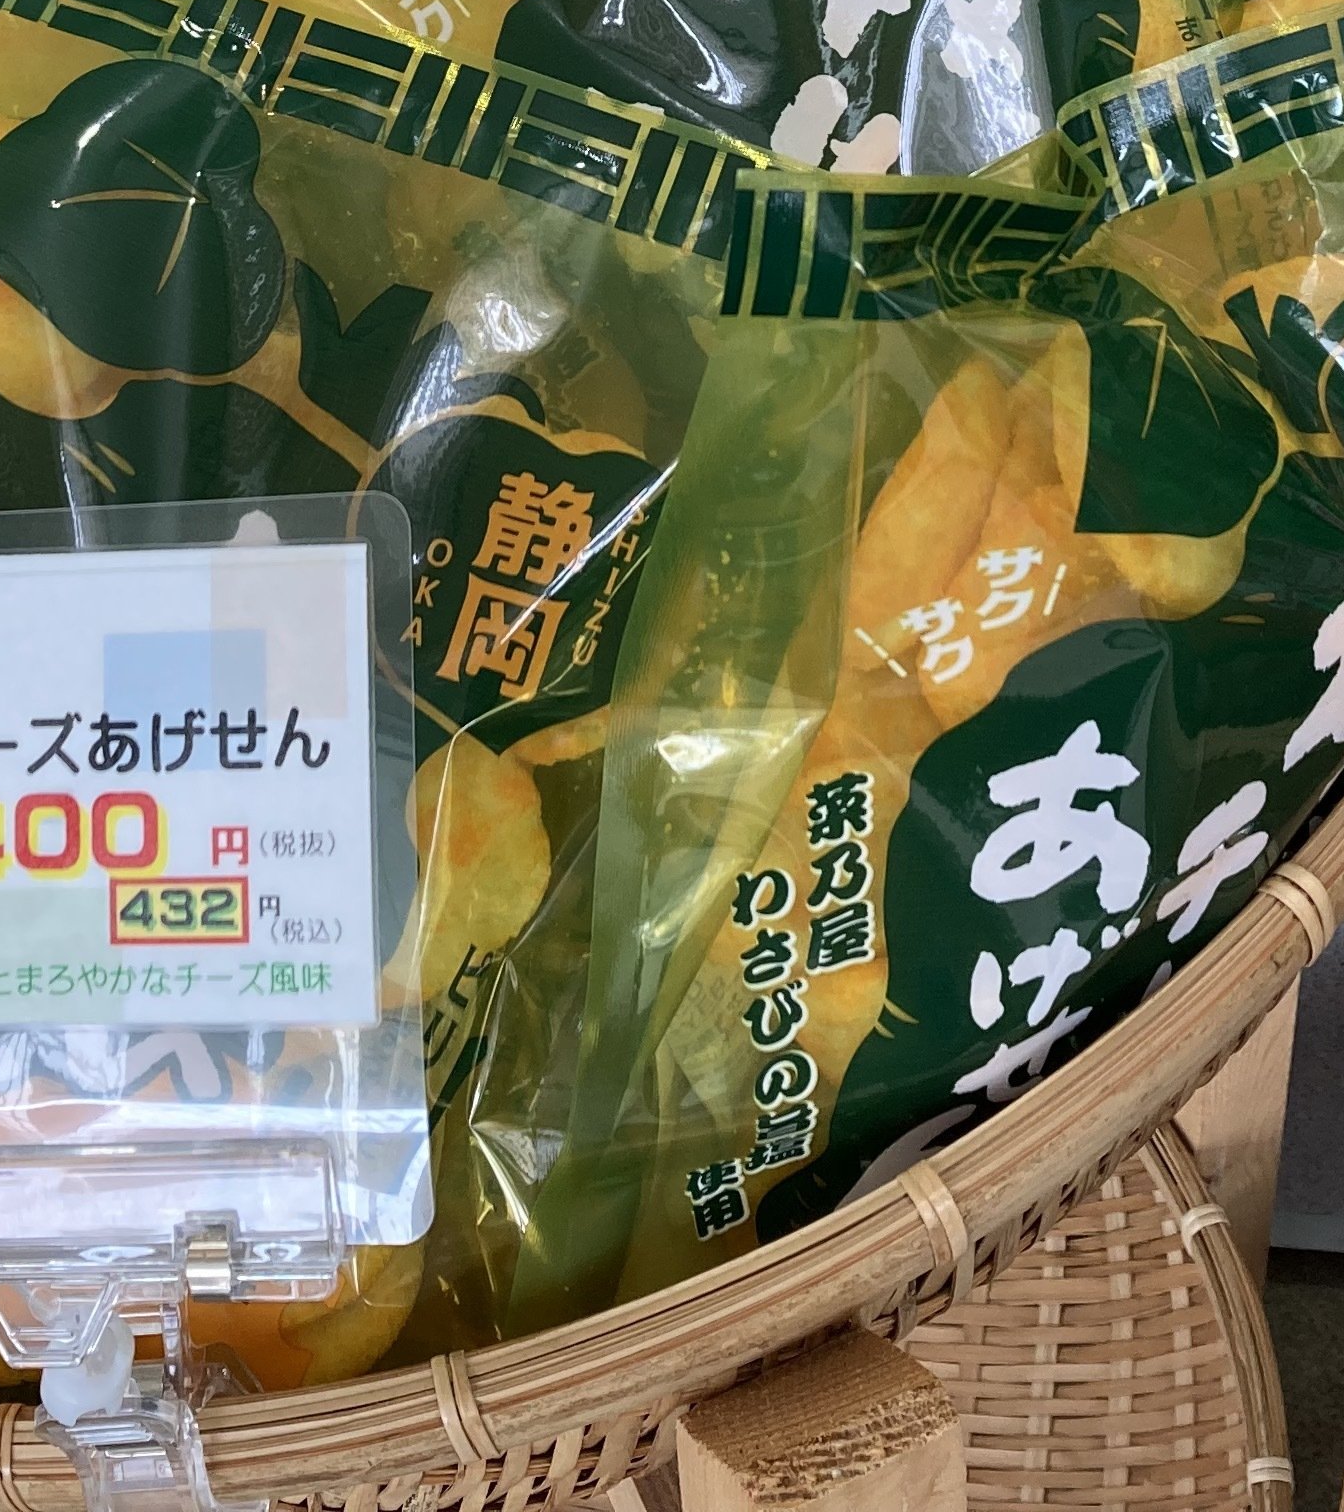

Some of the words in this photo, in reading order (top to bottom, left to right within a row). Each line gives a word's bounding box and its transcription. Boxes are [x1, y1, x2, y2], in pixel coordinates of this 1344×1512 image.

[401, 536, 451, 649] OKA
[434, 471, 596, 701] 静岡
[976, 544, 1045, 632] サク
[901, 597, 975, 685] サク
[210, 825, 249, 867] 円
[807, 772, 875, 973] 菜乃屋
[119, 887, 240, 930] 432
[258, 894, 282, 918] 円
[684, 1158, 751, 1243] 使用
